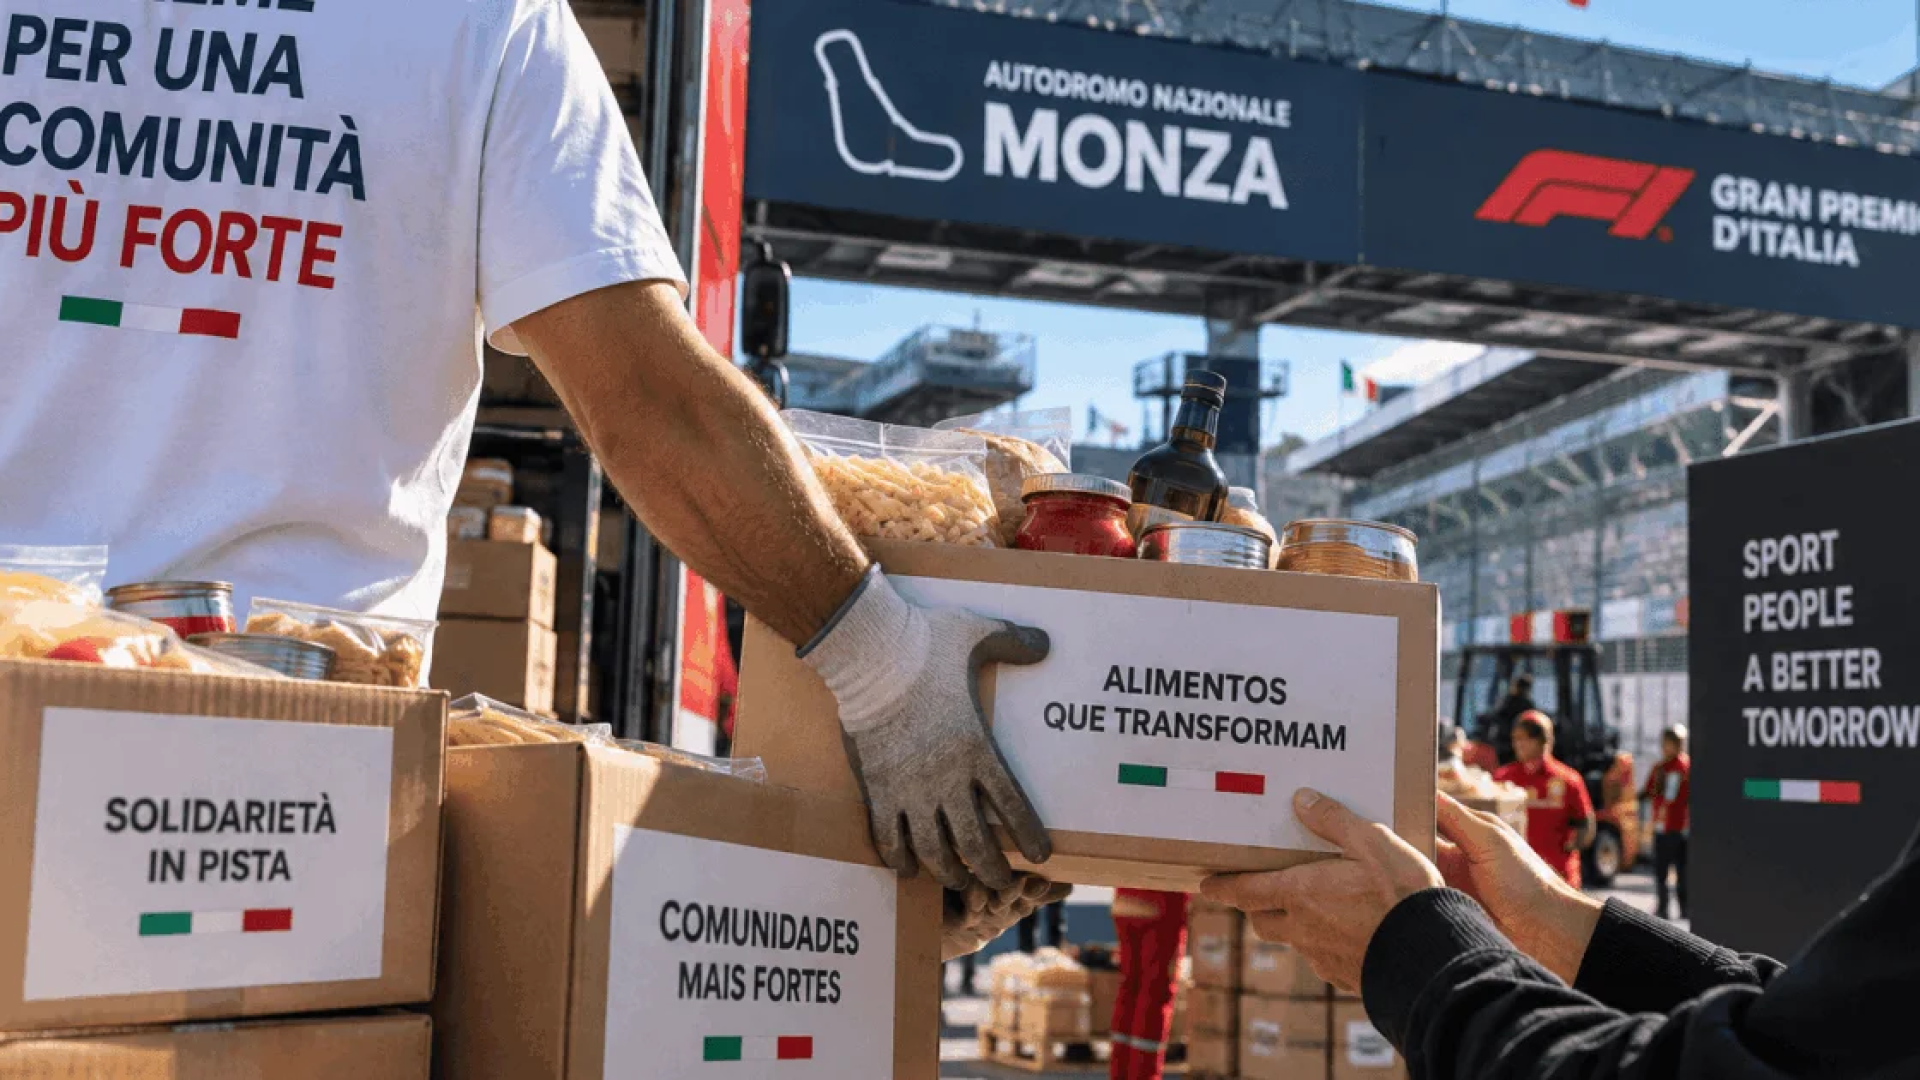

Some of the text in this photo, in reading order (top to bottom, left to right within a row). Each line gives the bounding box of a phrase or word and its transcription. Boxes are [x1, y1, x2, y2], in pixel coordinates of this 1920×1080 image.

[2, 13, 304, 100] PER UNA
[983, 60, 1292, 129] AUTODROMO NAZIONALE
[0, 101, 366, 202] COMUNITÀ
[983, 101, 1290, 210] MONZA
[1711, 173, 1920, 236] GRAN PREMI
[0, 179, 344, 290] PIÙ FORTE
[1712, 214, 1860, 268] D'ITALIA
[1743, 529, 1840, 579] SPORT
[1743, 585, 1854, 633] PEOPLE
[1103, 664, 1288, 706] ALIMENTOS
[1743, 647, 1882, 692] A BETTER
[1043, 702, 1347, 752] QUE TRANSFORMAM
[1742, 705, 1920, 748] TOMORROW
[105, 792, 337, 834] SOLIDARIETÀ
[147, 849, 292, 883] IN PISTA
[659, 899, 860, 956] COMUNIDADES
[677, 961, 842, 1005] MAIS FORTES
